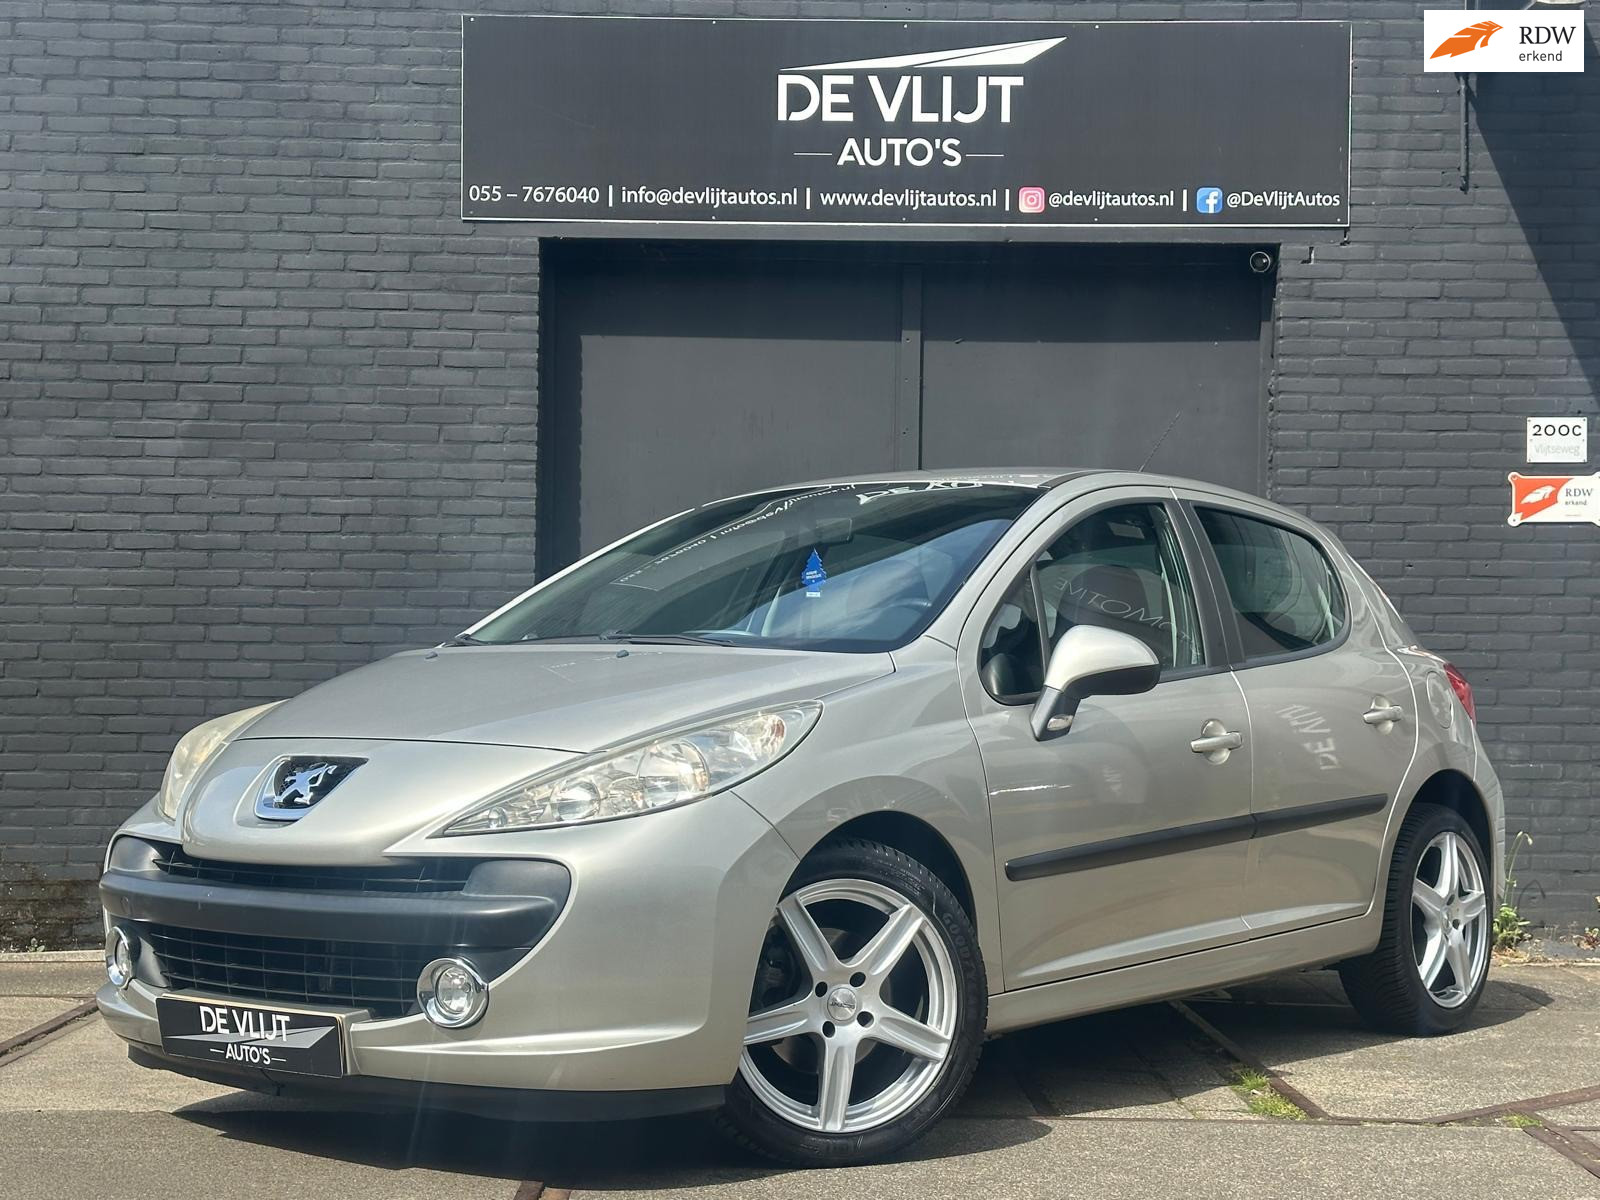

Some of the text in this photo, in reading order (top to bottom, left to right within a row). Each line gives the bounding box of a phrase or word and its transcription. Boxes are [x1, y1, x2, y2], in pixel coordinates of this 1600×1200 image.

[777, 74, 1024, 124] DE VLIJT
[836, 137, 962, 167] AUTO'S
[469, 185, 502, 202] 055
[522, 186, 600, 204] 7676040
[621, 185, 798, 209] info@devlijtautos.nl
[819, 188, 997, 211] www.devlijtautos.nl
[1048, 190, 1174, 210] @devlijtautos.nl
[1226, 190, 1341, 210] @DeVlijtAutos
[1565, 488, 1593, 497] RDW
[199, 1005, 291, 1042] DE VLIJT
[225, 1043, 272, 1065] AUTO'S
